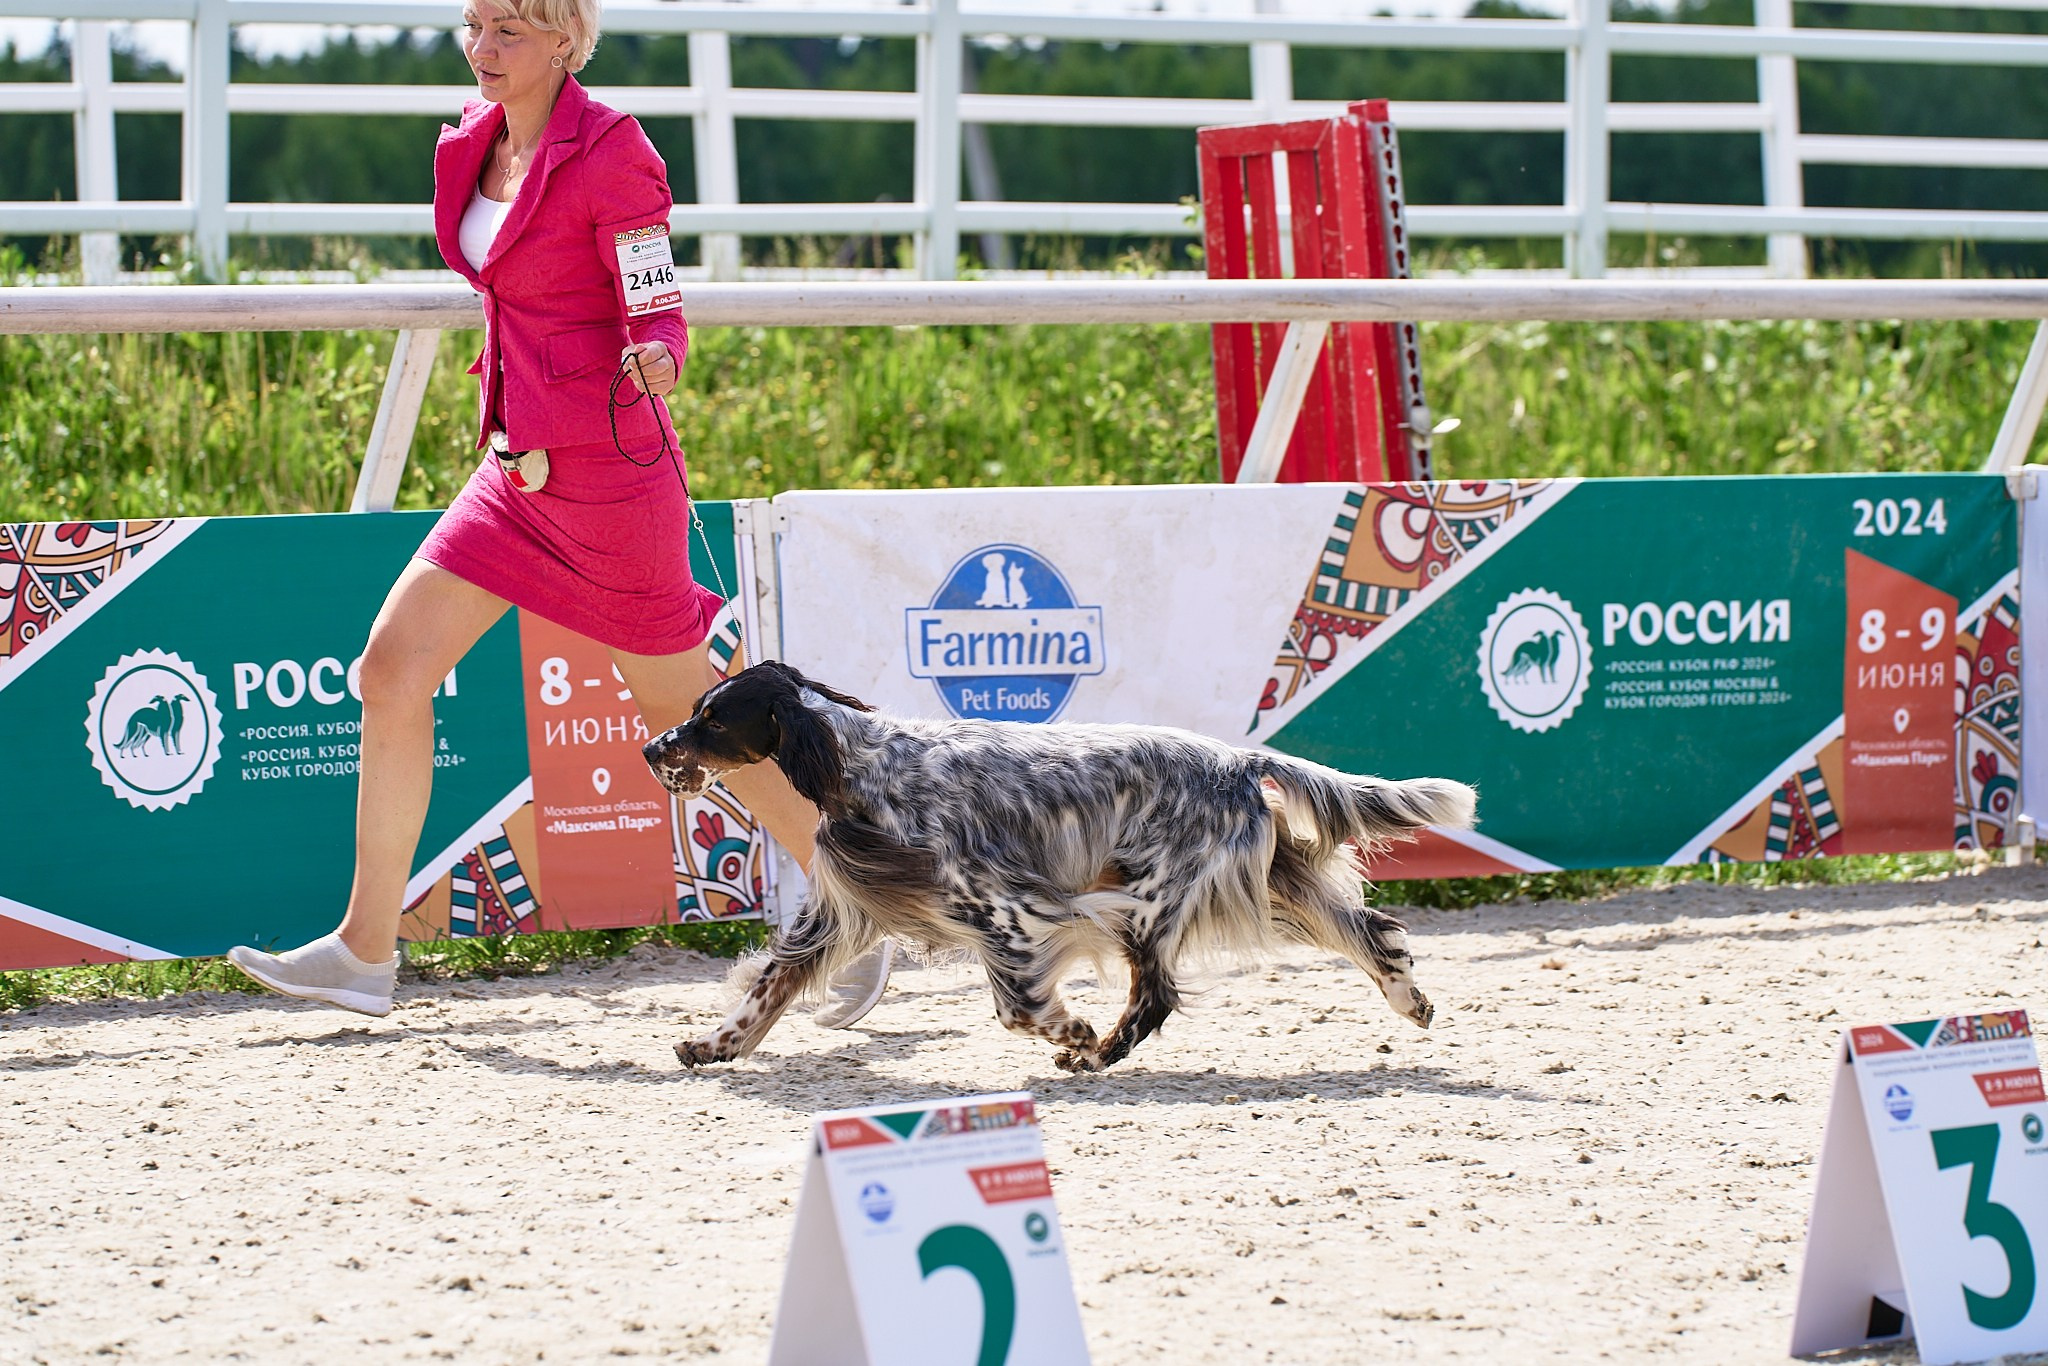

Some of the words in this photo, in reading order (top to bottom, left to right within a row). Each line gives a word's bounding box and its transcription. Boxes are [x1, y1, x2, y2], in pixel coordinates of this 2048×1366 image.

[627, 265, 674, 291] 2446
[1853, 498, 1948, 536] 2024
[1603, 599, 1791, 646] РОССИЯ
[921, 618, 1091, 667] Farmina
[1669, 658, 1710, 672] КУБОК
[1858, 662, 1945, 689] ИЮНЯ
[1669, 678, 1710, 692] КУБОК
[1713, 677, 1768, 690] МОСКВЫ
[962, 689, 991, 711] Pet
[997, 687, 1051, 710] Foods
[1604, 696, 1646, 709] КУБОК
[1649, 694, 1708, 708] ГОРОДОВ
[1711, 693, 1756, 706] ГЕРОЕВ
[239, 723, 313, 740] «РОССИЯ.
[545, 715, 649, 746] ИЮНЯ
[439, 737, 449, 750] &
[241, 747, 315, 763] «РОССИЯ.
[242, 765, 291, 781] КУБОК
[544, 803, 611, 817] Московская
[546, 819, 616, 834] «Максима
[618, 815, 662, 832] Парк»
[1930, 1122, 2036, 1331] 3
[917, 1223, 1016, 1366] 2
